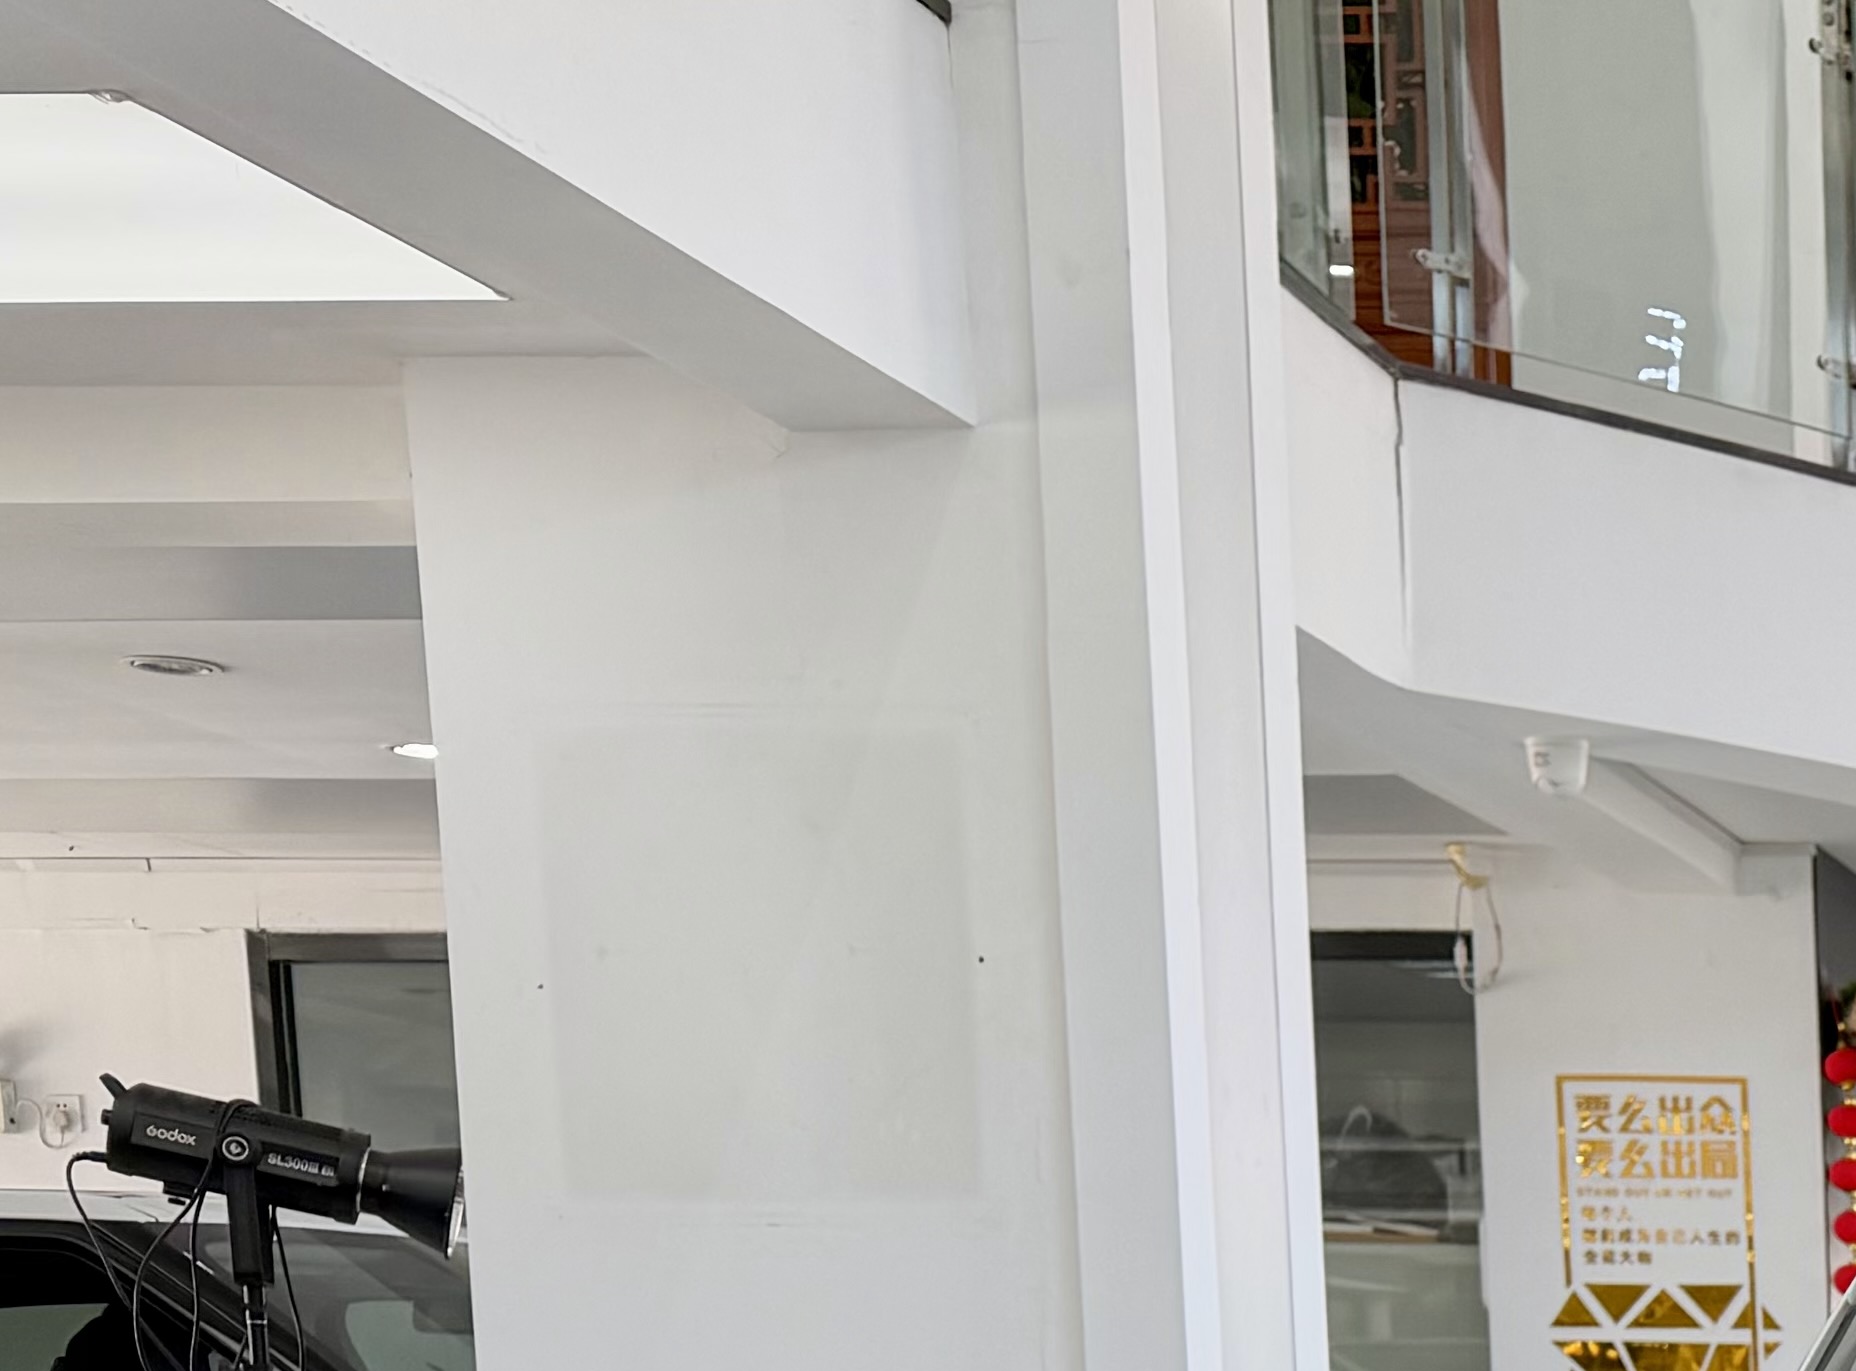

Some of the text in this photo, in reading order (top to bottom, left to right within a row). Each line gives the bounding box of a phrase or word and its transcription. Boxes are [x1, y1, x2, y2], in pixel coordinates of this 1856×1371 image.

[146, 1124, 197, 1147] Godox
[1575, 1094, 1737, 1136] 要么出众
[1576, 1139, 1739, 1180] 要么出局
